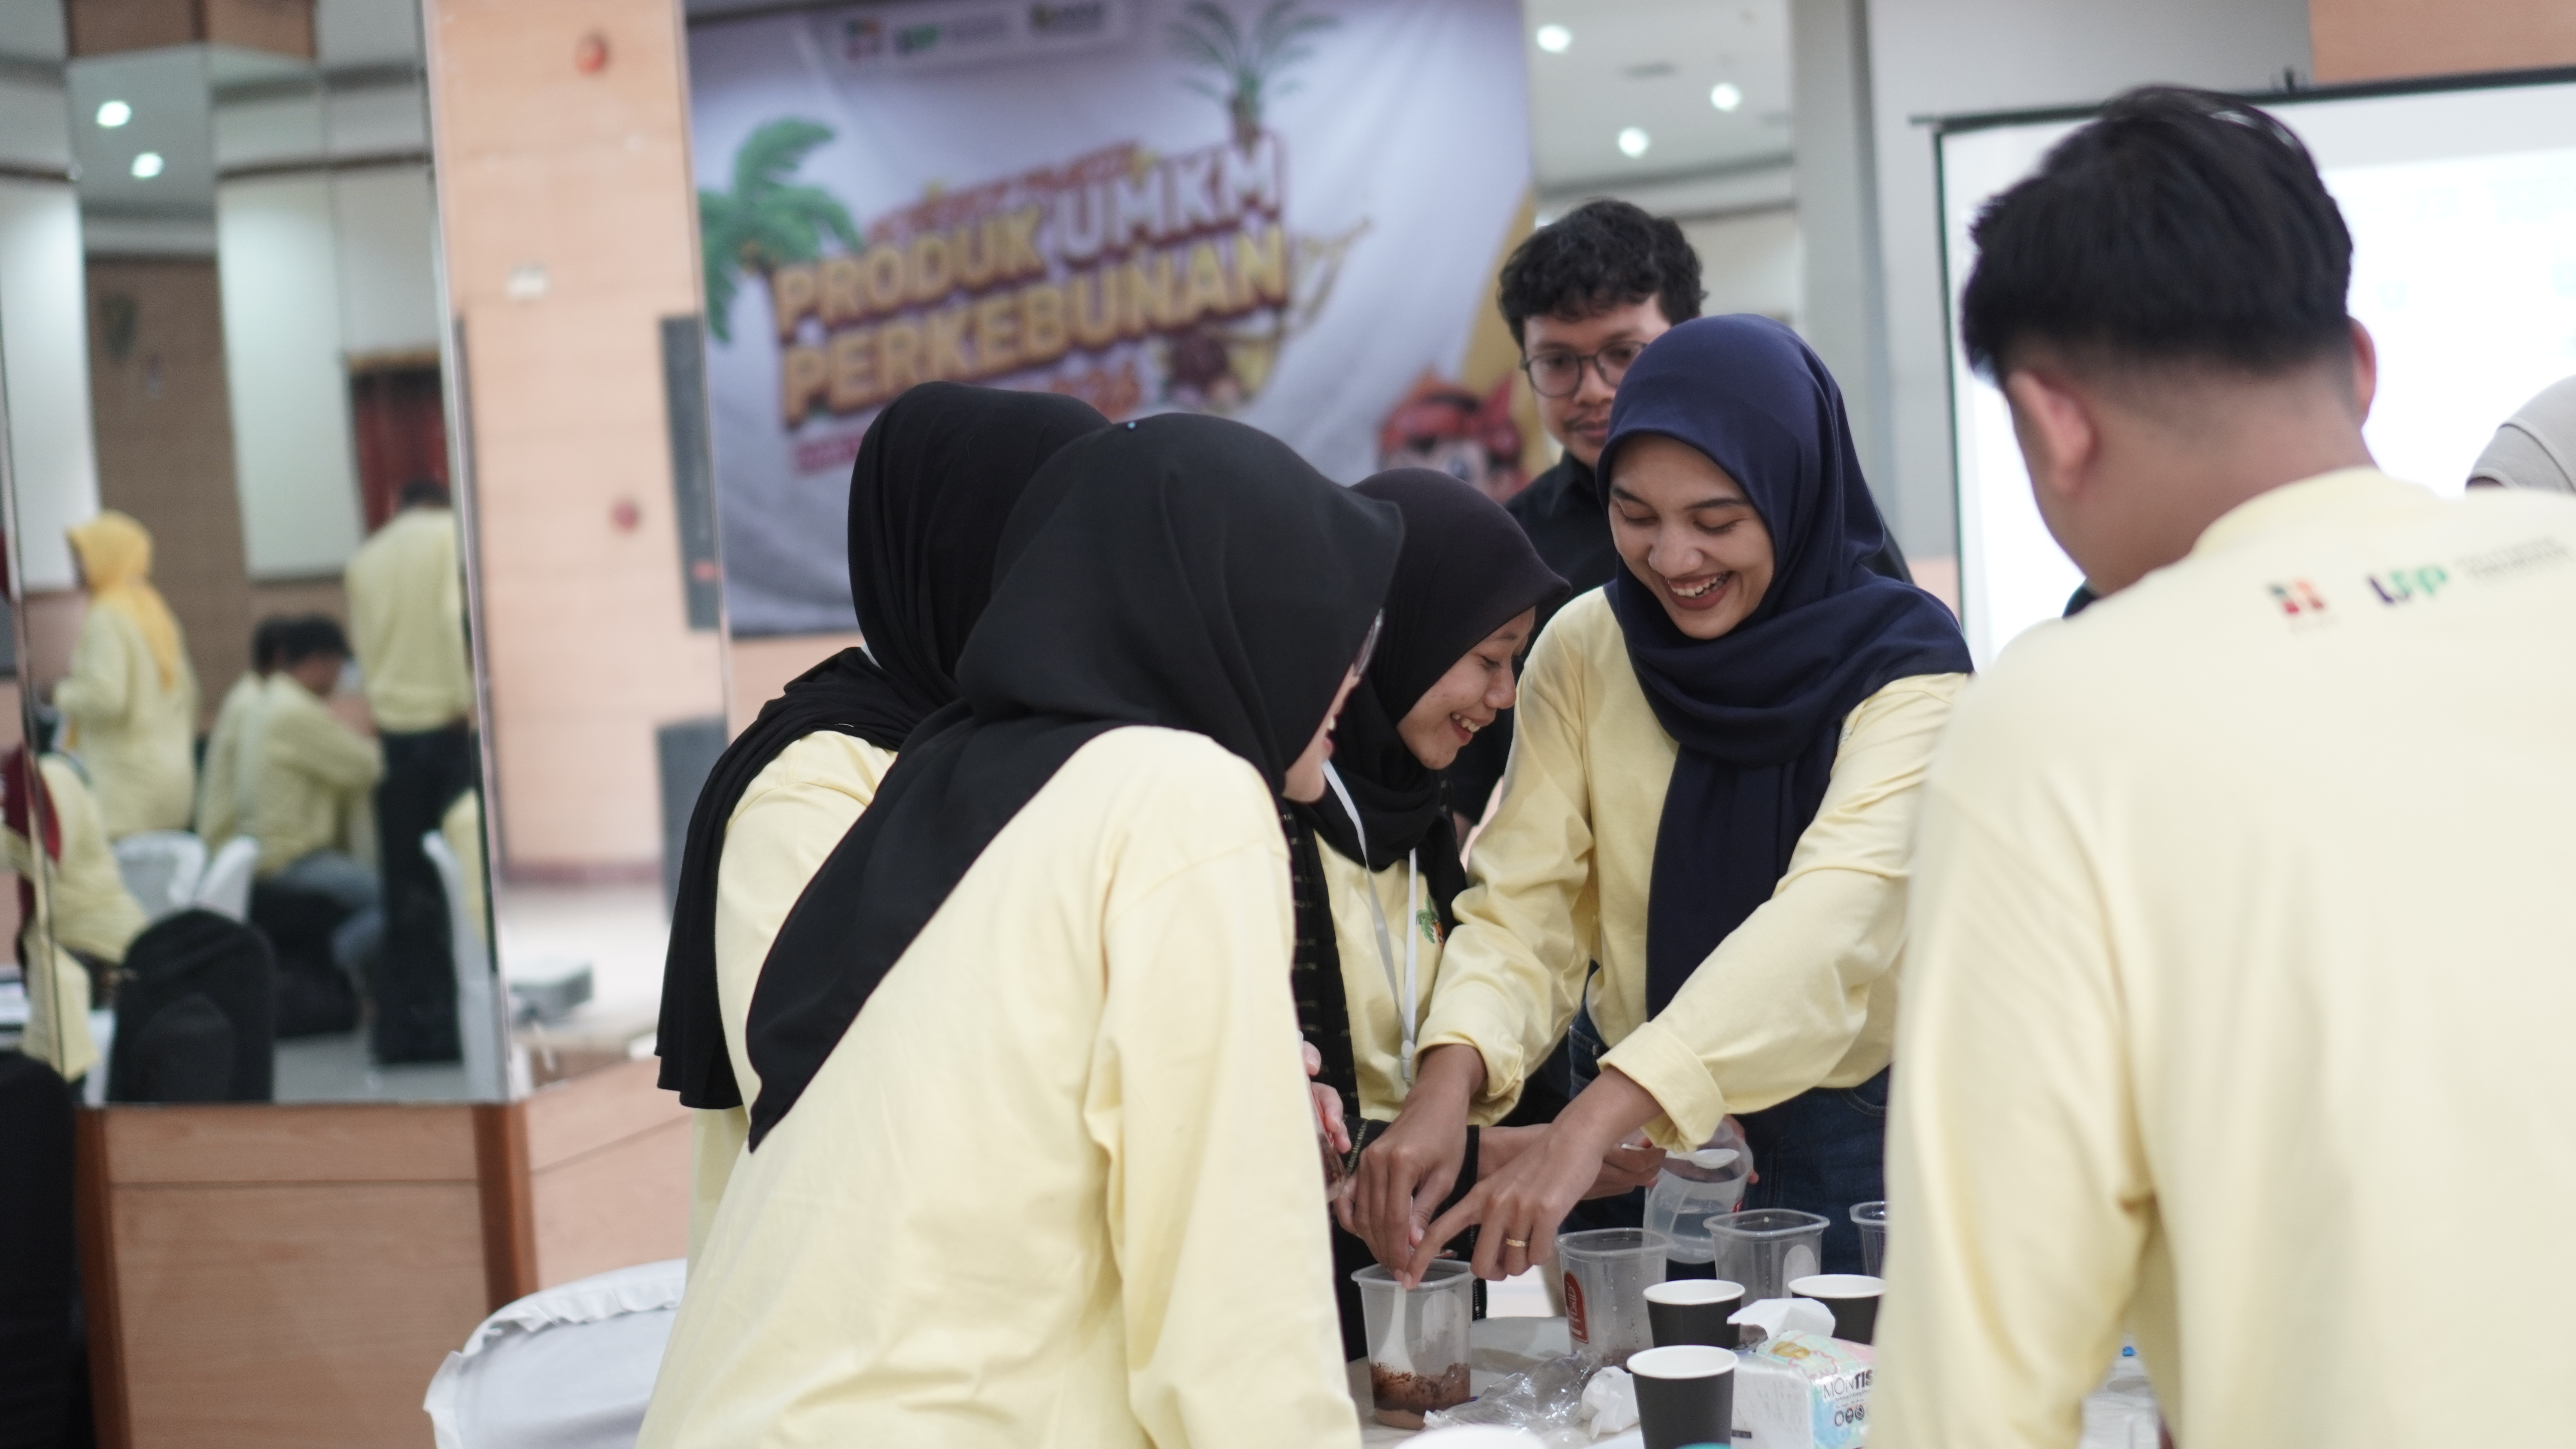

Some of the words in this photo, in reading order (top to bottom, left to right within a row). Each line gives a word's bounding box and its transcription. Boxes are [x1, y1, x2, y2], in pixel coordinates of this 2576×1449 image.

[774, 205, 1048, 333] PRODUK
[1055, 136, 1281, 261] UMKM
[782, 221, 1287, 426] PERKEBUNAN
